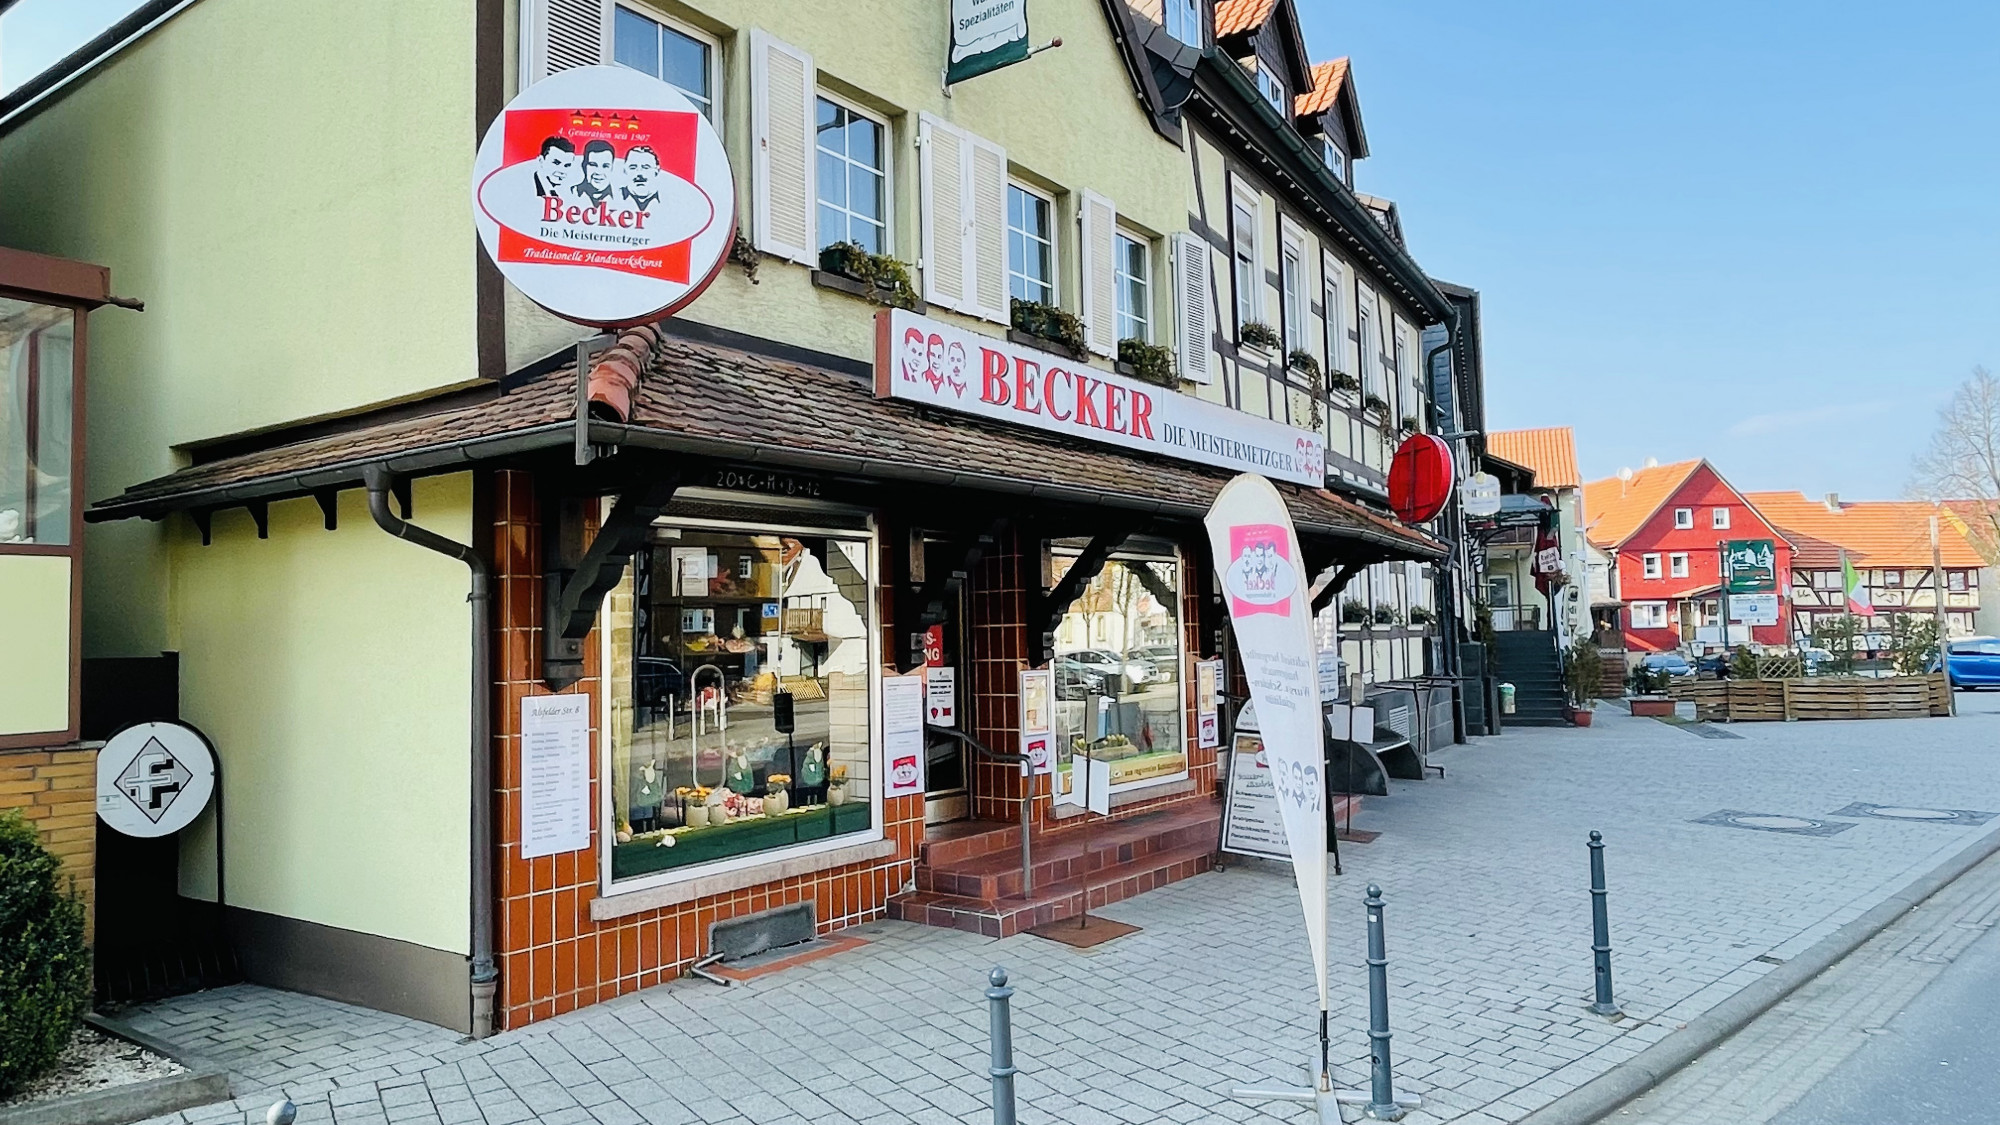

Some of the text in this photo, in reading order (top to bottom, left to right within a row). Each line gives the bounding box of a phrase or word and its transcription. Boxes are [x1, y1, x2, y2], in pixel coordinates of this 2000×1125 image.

[959, 0, 1014, 30] Spezialitäten
[568, 129, 611, 140] Generation
[630, 134, 651, 142] 1907
[541, 195, 651, 229] Becker
[540, 226, 651, 246] Die Meistermetzger
[523, 248, 663, 269] Traditionelle Handwerkskunst
[979, 347, 1155, 441] BECKER
[1163, 423, 1293, 472] DIE MEISTERMETZGER
